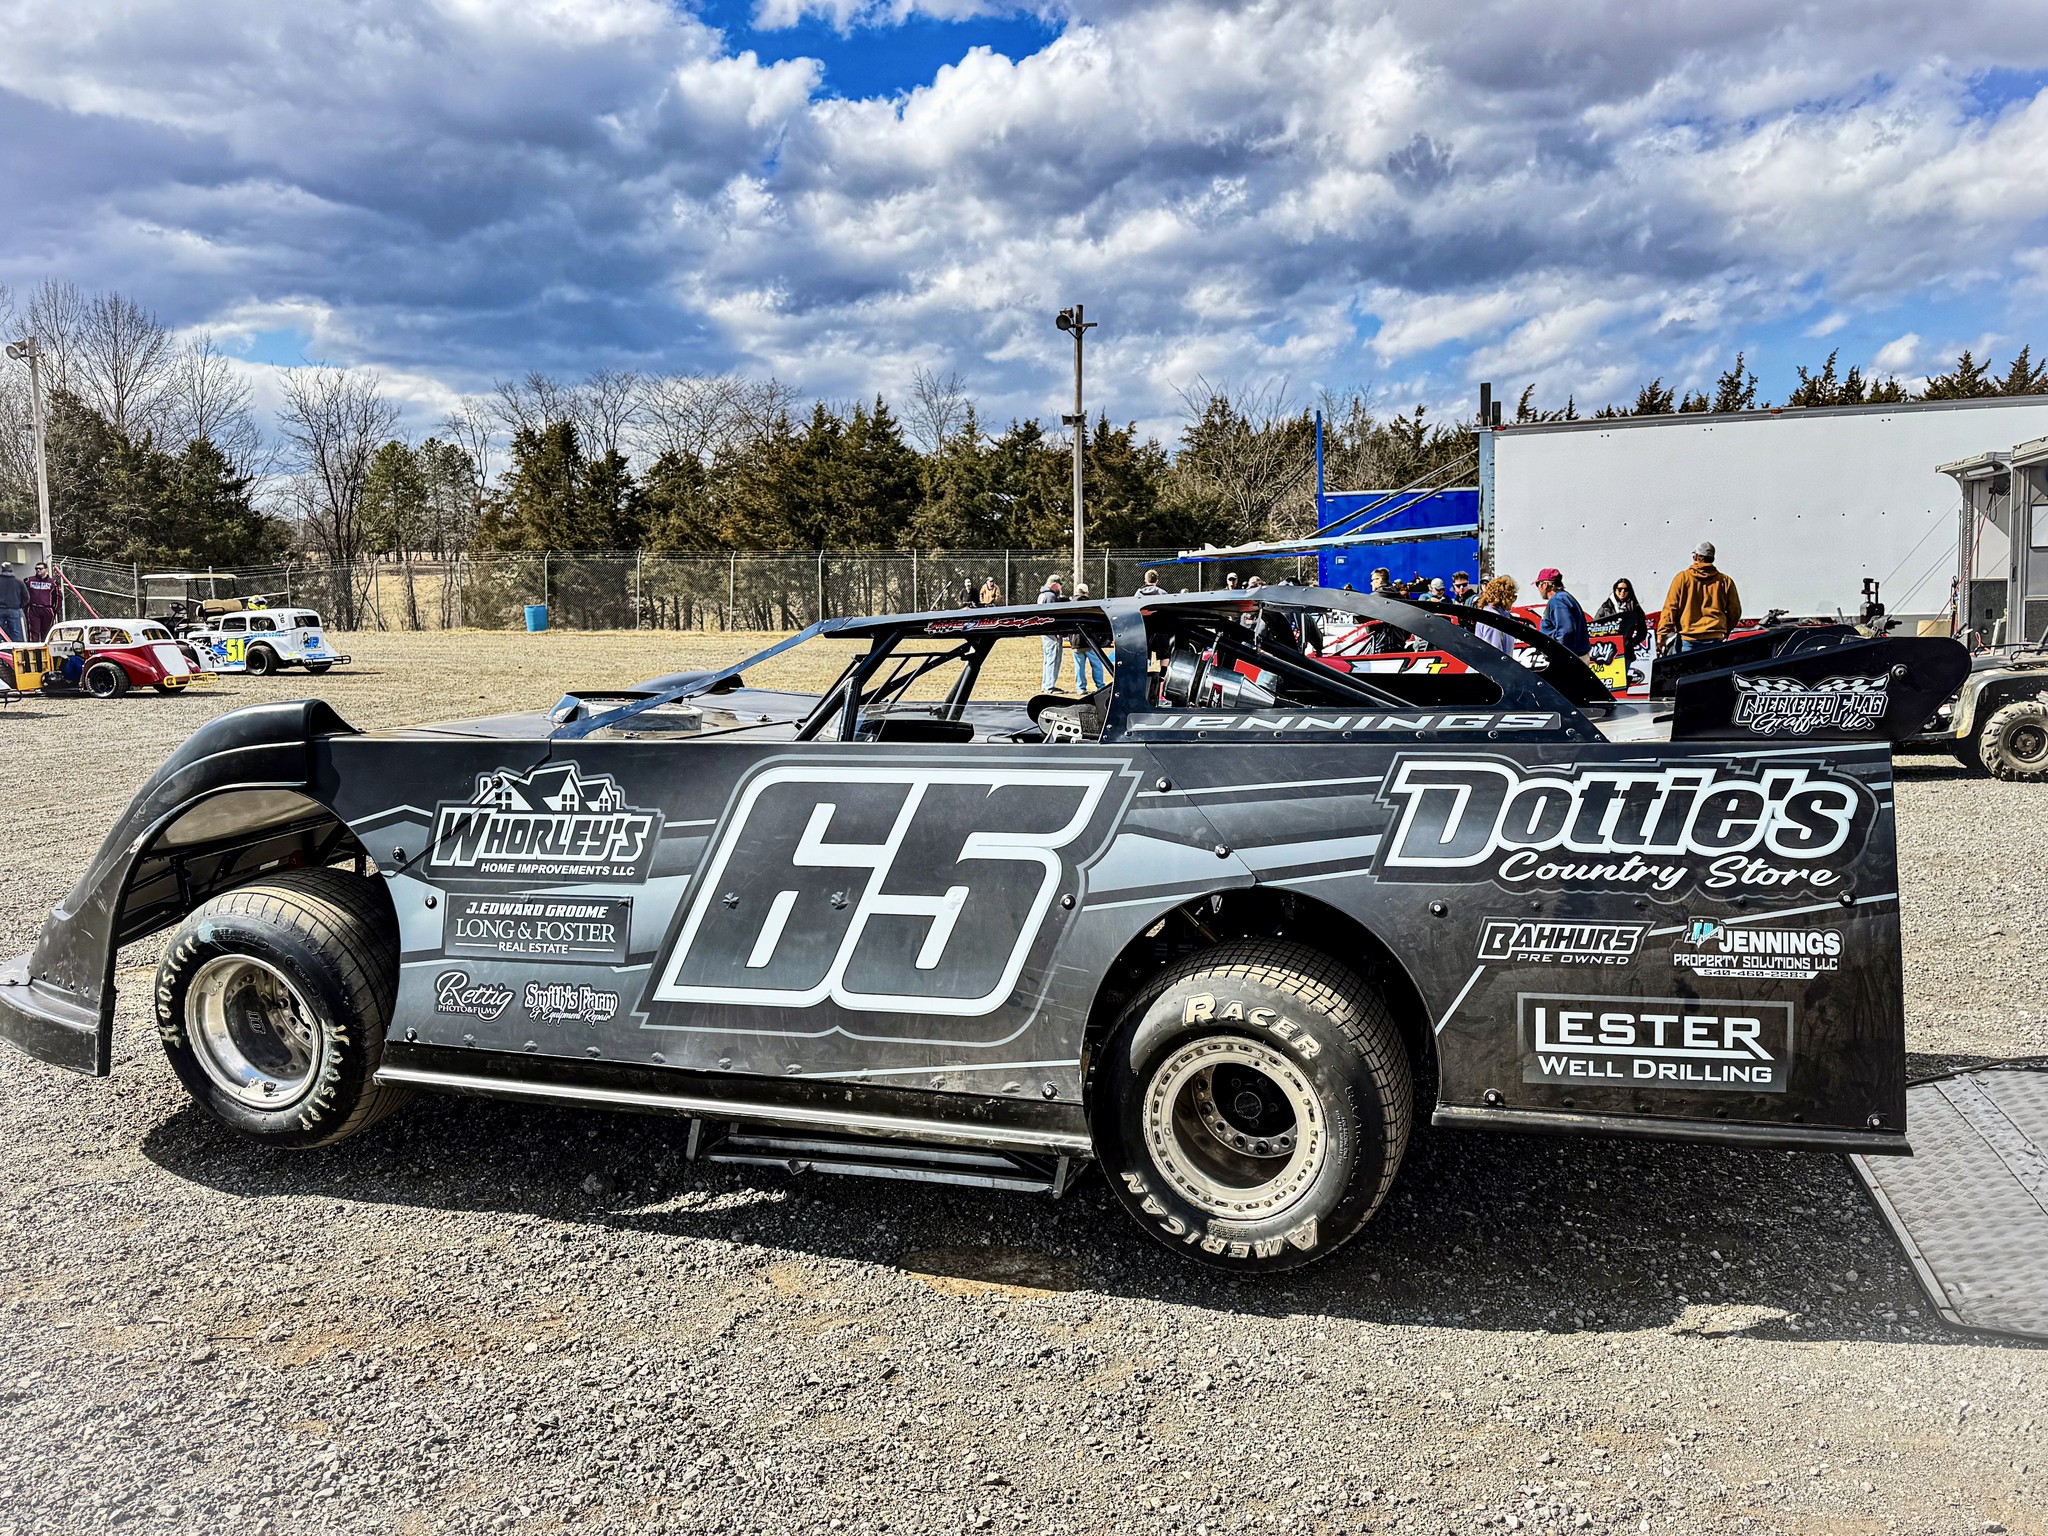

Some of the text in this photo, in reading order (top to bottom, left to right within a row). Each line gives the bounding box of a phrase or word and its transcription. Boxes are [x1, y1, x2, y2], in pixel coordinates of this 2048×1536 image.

[226, 638, 245, 662] 51
[1736, 692, 1889, 723] CHECKERED FLAG
[1131, 714, 1555, 730] JENNINGS
[1752, 711, 1831, 734] Graffix
[1384, 760, 1859, 868] Dottie's
[430, 807, 653, 867] WHORLEY'S
[481, 863, 636, 876] HOME IMPROVEMENTS LLC
[1498, 852, 1843, 890] Country Store
[653, 766, 1114, 1016] 65
[466, 902, 609, 919] J.EDWARD GROOME
[455, 918, 616, 943] LONG & FOSTER
[1719, 930, 1840, 956] JENNINGS
[498, 941, 569, 954] REAL ESTATE
[1517, 953, 1630, 965] PRE OWNED
[1673, 953, 1838, 971] PROPERTY SOLUTIONS LLC
[436, 971, 514, 1020] Rettig
[525, 982, 620, 1016] Smith's Farm
[530, 1007, 611, 1028] & Equipment Repair
[1535, 1007, 1775, 1061] LESTER
[1537, 1055, 1772, 1083] WELL DRILLING
